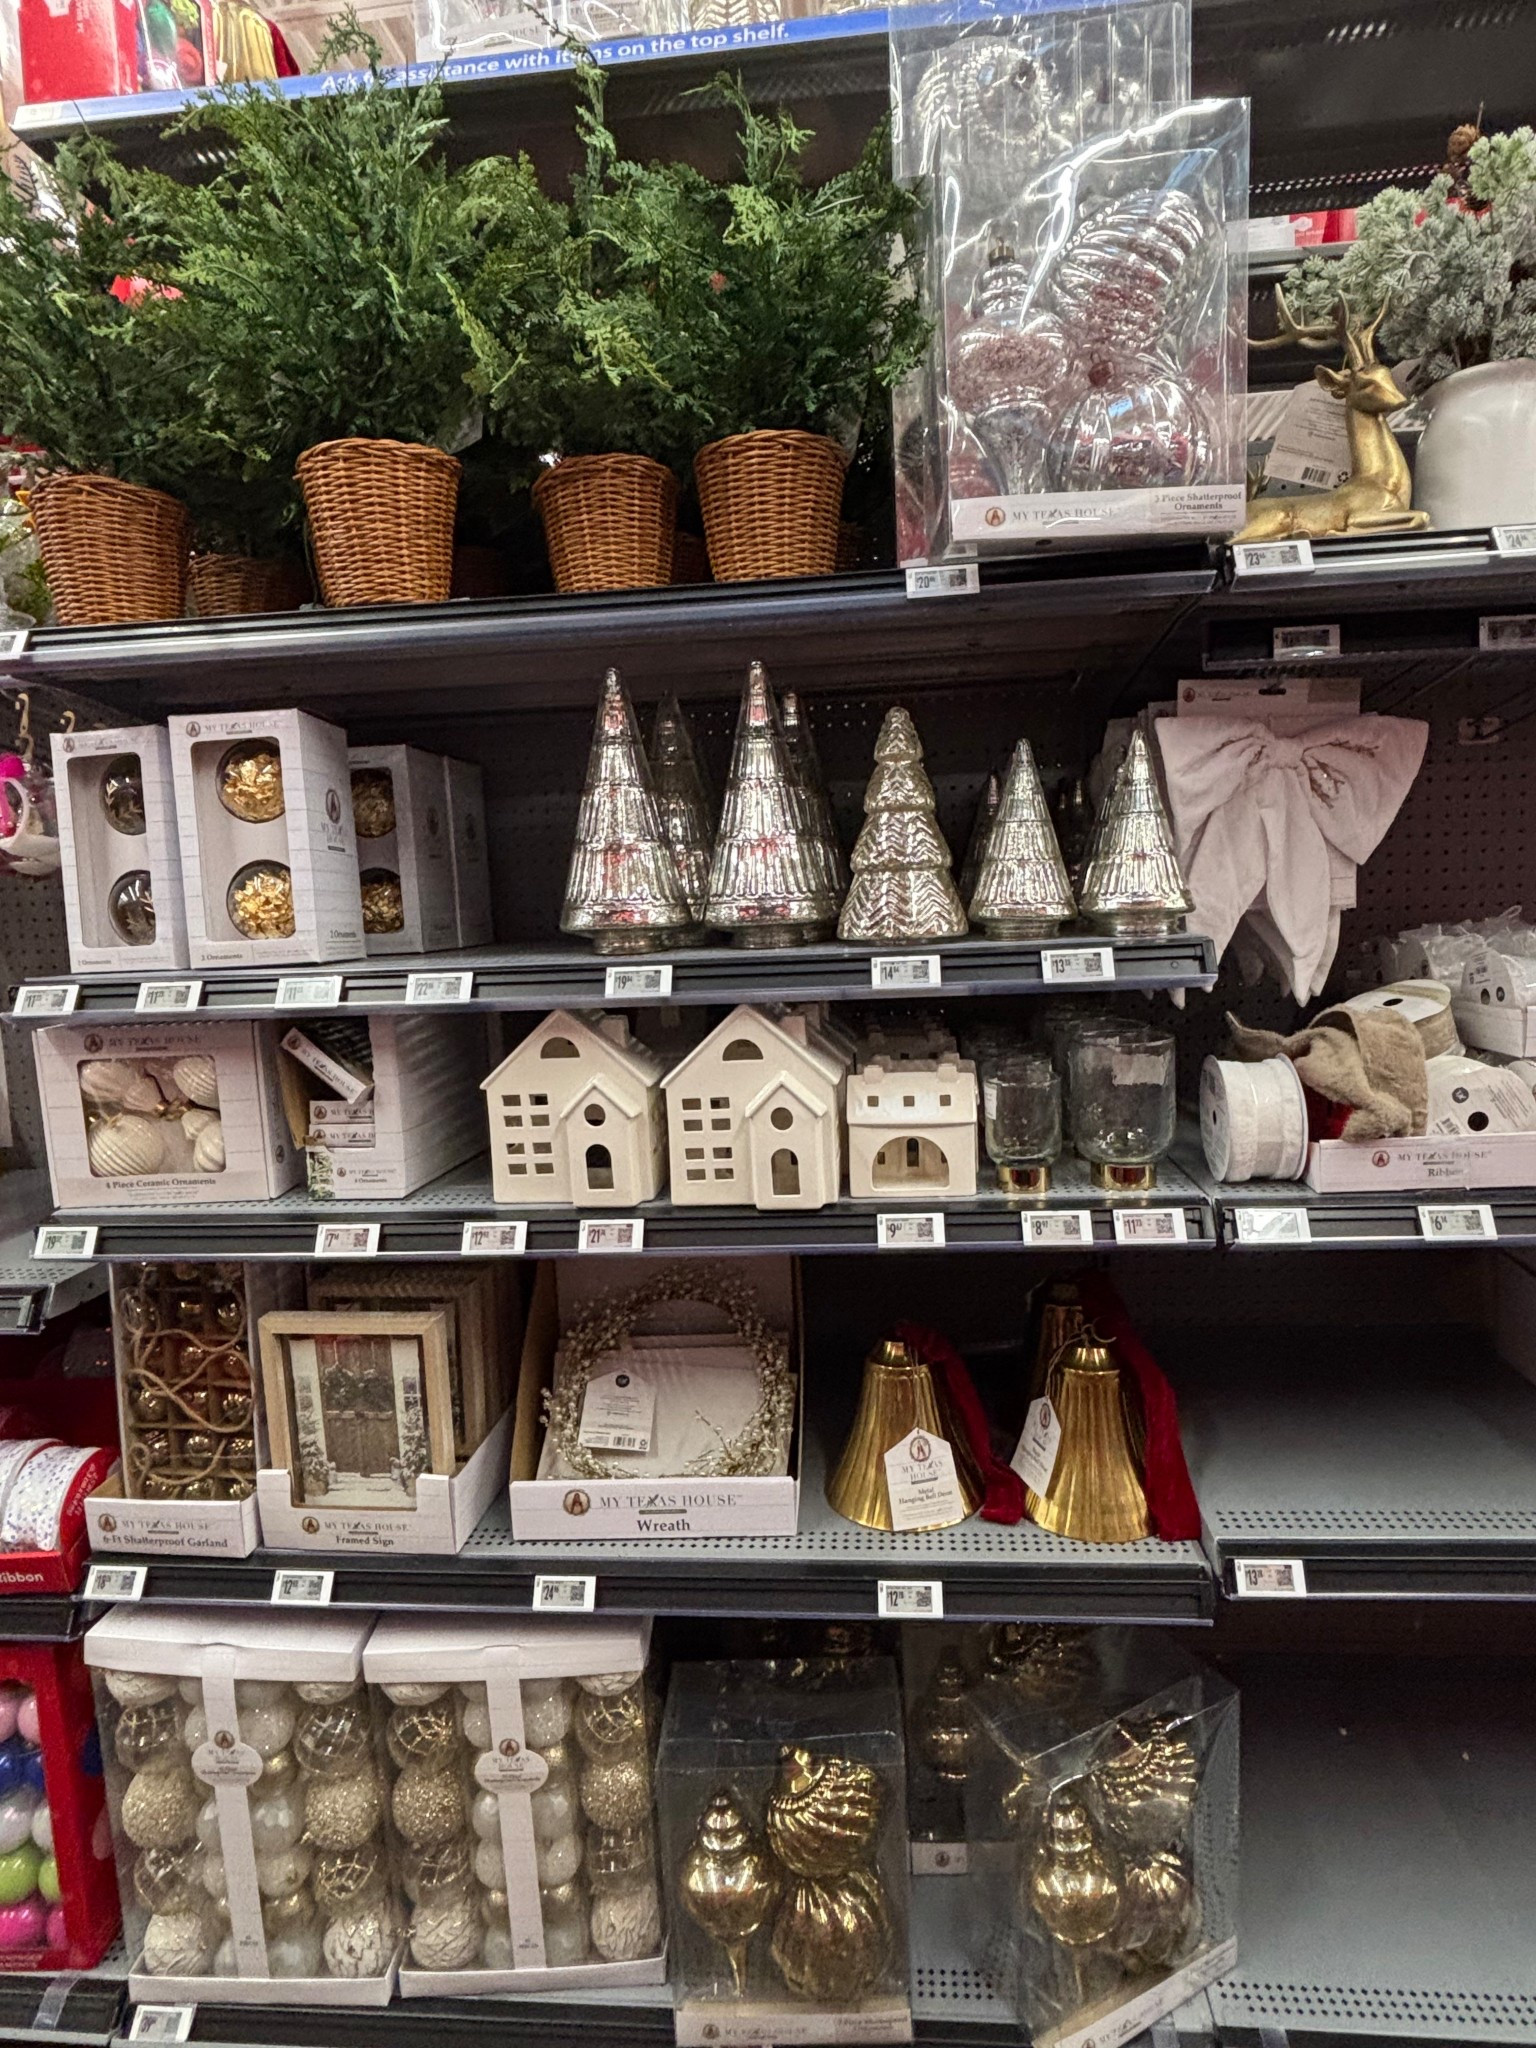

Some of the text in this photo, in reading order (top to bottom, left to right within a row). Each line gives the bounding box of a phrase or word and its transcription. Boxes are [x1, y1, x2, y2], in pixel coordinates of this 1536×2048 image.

[321, 74, 358, 91] Ask
[396, 58, 500, 82] assistance
[505, 52, 550, 73] with
[617, 42, 645, 57] on
[650, 37, 687, 53] the
[691, 32, 728, 50] top
[732, 22, 790, 44] shelf.
[1187, 490, 1243, 504] Shatterproof
[1173, 501, 1223, 512] Ornaments
[1011, 510, 1031, 522] MY
[1034, 507, 1072, 522] TEXAS
[1397, 1153, 1411, 1162] MY
[113, 1181, 135, 1190] Piece
[135, 1179, 169, 1189] Ceramic
[170, 1177, 217, 1188] Ornaments
[599, 1493, 738, 1509] MY TEXAS HOUSE
[636, 1518, 691, 1533] Wreath
[123, 1535, 186, 1548] Shatterproof
[187, 1536, 229, 1549] Garland
[336, 1535, 394, 1548] Framed Sign
[0, 1571, 44, 1584] ibbon
